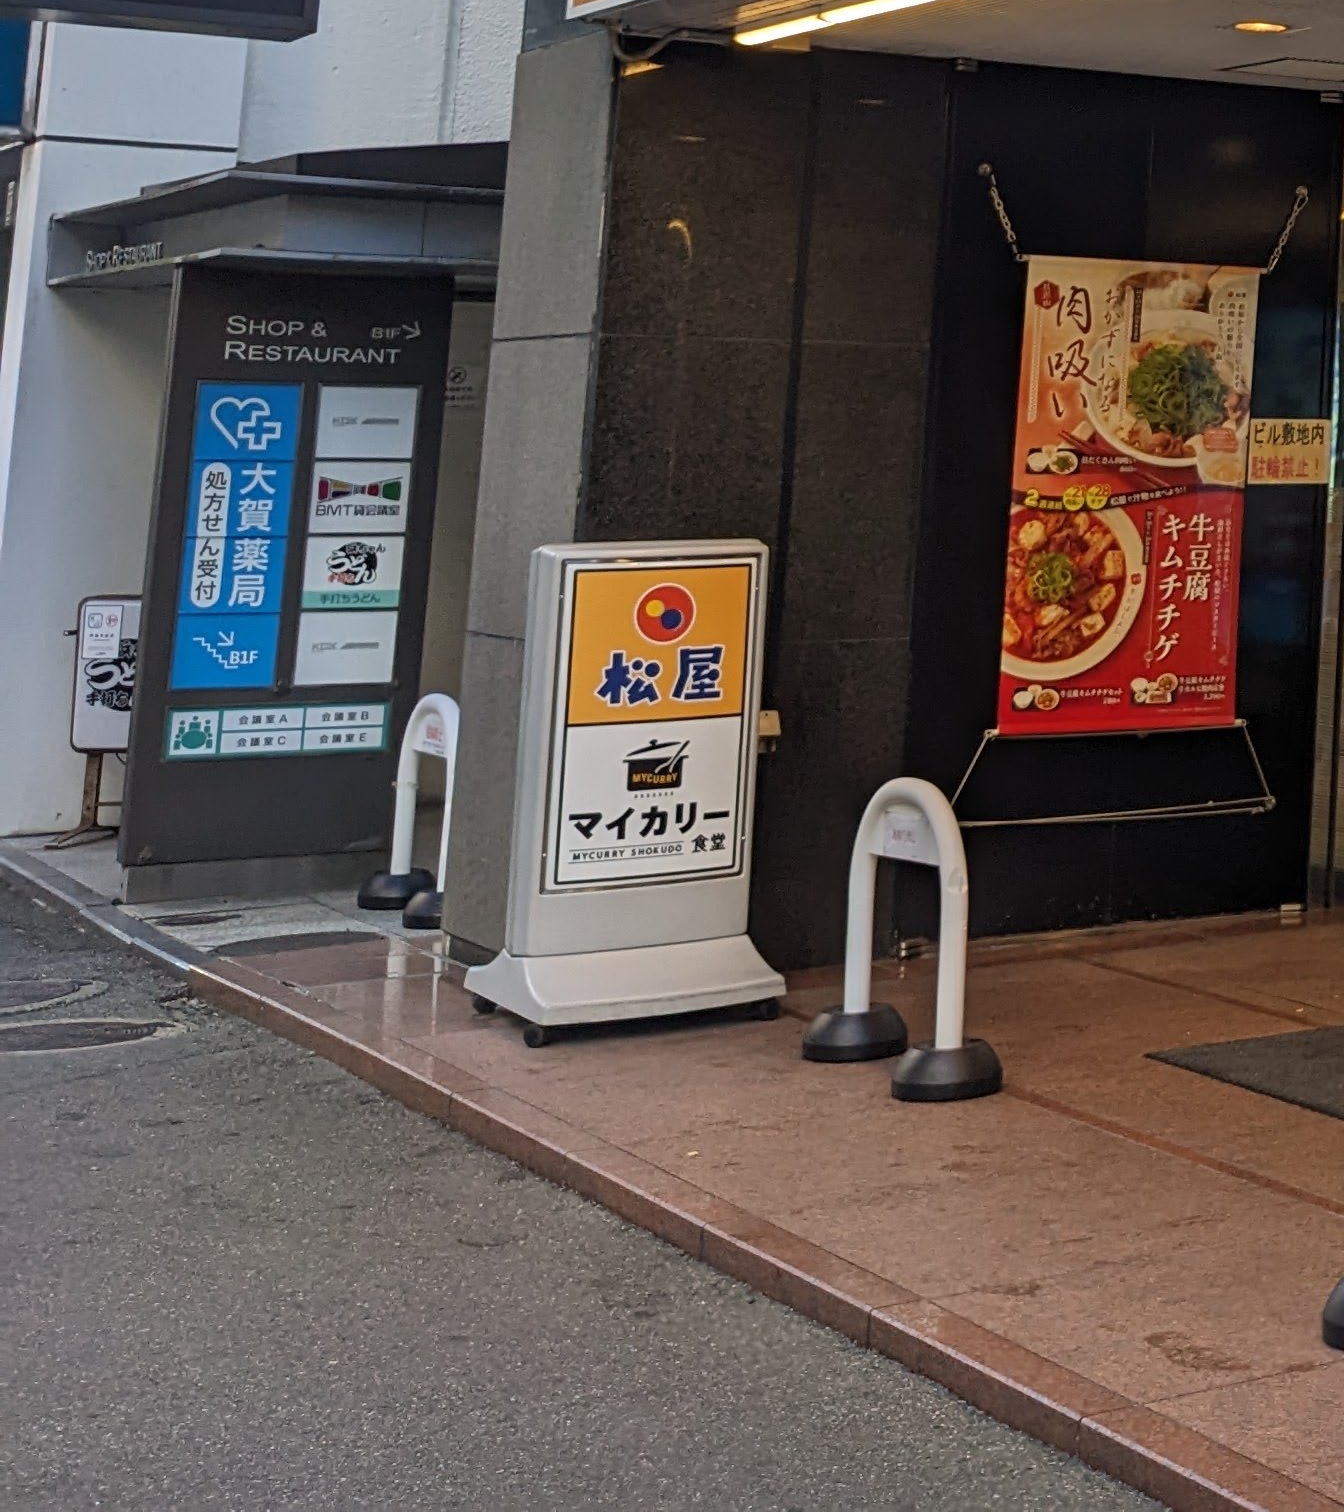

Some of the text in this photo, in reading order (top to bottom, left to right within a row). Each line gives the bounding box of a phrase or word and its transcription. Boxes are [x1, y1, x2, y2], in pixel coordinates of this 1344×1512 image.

[310, 321, 328, 338] &
[1047, 285, 1098, 419] 肉吸い
[1253, 421, 1325, 446] ビル敷地内
[195, 470, 227, 602] 処方せん受付
[227, 463, 277, 608] 大賀薬局
[1183, 513, 1215, 602] 牛豆腐
[1154, 513, 1187, 662] キムチチゲ
[229, 650, 259, 665] B1F
[594, 644, 725, 707] 松屋
[631, 772, 678, 784] MYCURRY
[568, 801, 730, 840] マイカリー
[572, 844, 683, 861] MYCURRY SHOKUDO
[691, 833, 726, 854] 食堂
